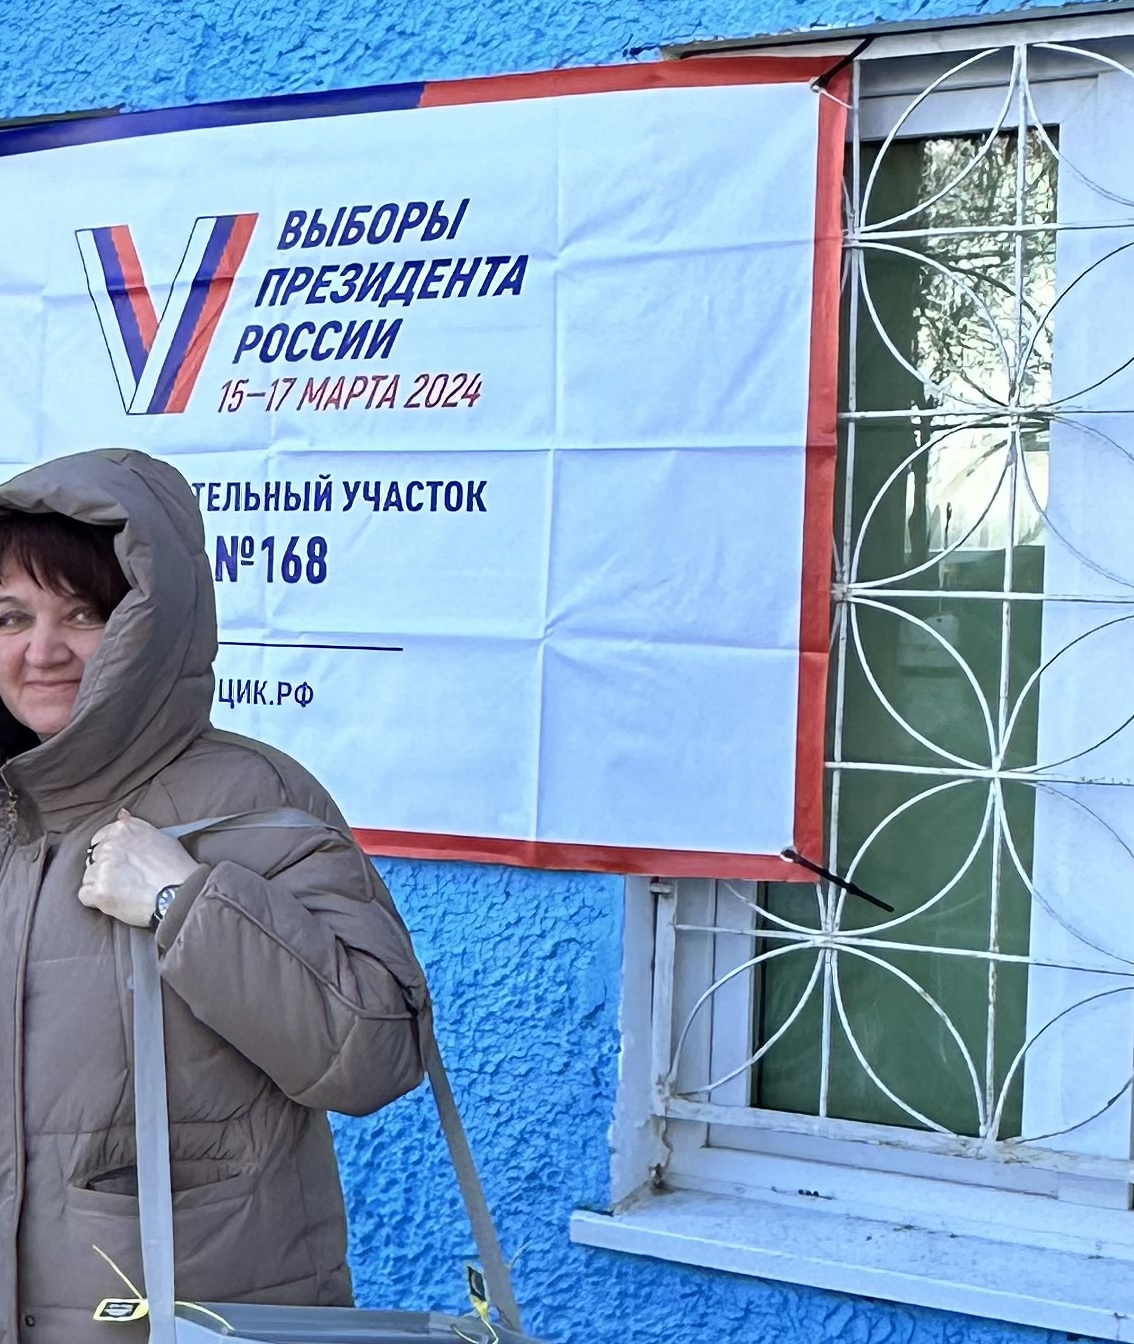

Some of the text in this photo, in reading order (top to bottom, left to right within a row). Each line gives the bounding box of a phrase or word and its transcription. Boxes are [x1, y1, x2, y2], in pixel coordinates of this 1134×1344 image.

[277, 197, 471, 251] ВЫБОРЫ
[254, 254, 530, 308] ПРЕЗИДЕНТА
[231, 317, 404, 365] РОССИИ
[296, 373, 401, 412] МАРТА
[402, 372, 483, 409] 2024
[191, 474, 488, 513] ТЕЛЬНЫЙ УЧАСТОК
[215, 535, 329, 585] №168
[218, 678, 315, 709] ЦИК.РФ
